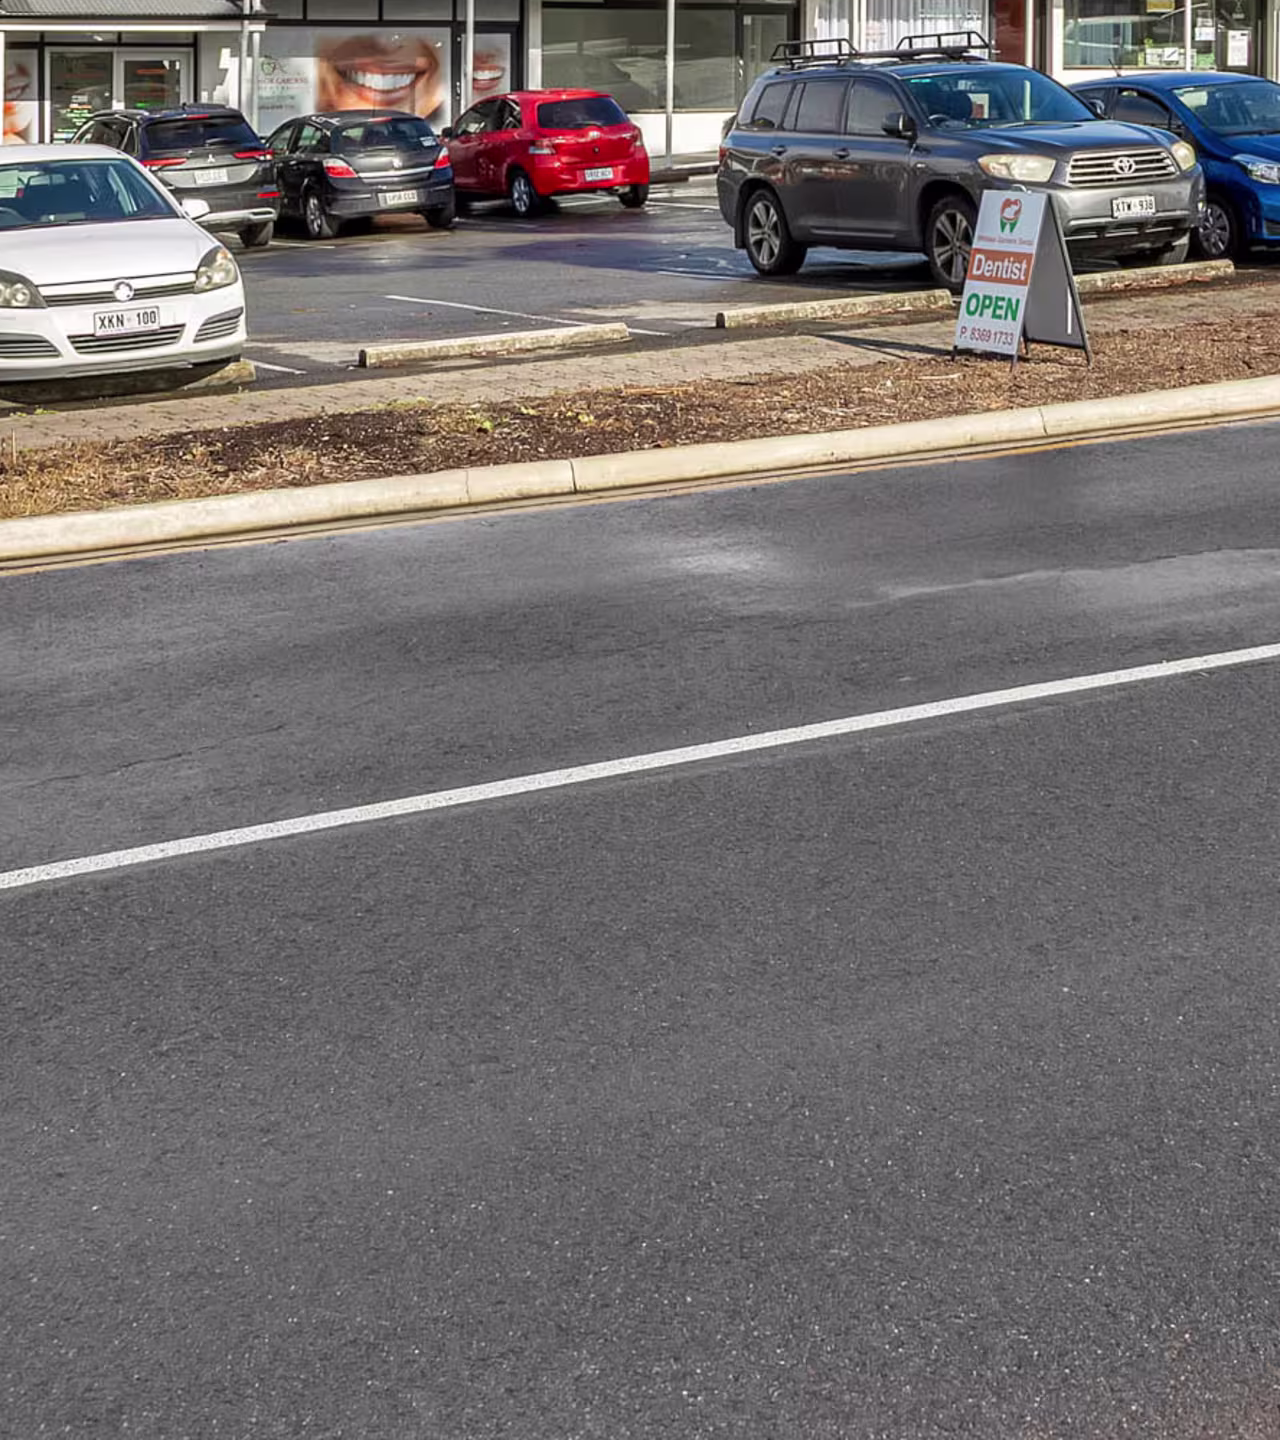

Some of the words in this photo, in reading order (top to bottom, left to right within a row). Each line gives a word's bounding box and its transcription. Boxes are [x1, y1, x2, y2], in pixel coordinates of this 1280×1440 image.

[972, 254, 1027, 280] Dentist
[966, 293, 1020, 321] OPEN
[99, 314, 124, 329] XKN
[136, 311, 156, 325] 100
[970, 326, 992, 342] 8369
[993, 331, 1015, 346] 1733
